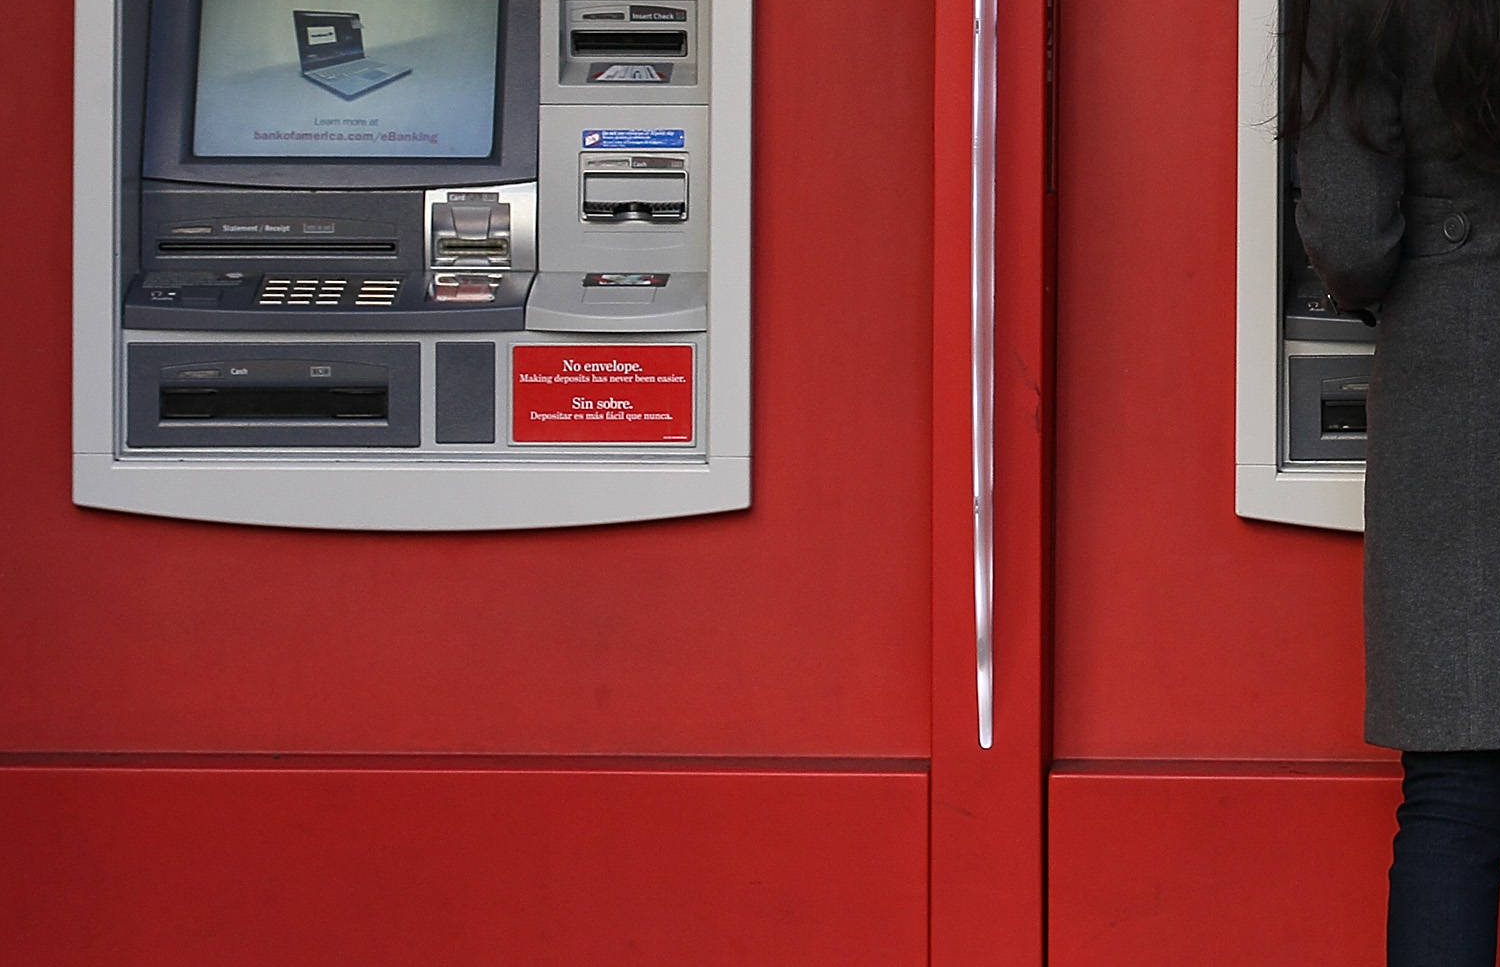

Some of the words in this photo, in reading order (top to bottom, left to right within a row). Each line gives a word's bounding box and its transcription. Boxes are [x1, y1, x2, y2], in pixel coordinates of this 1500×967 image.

[314, 117, 340, 126] Learn
[563, 360, 581, 371] No
[584, 360, 642, 374] envelope.
[520, 374, 552, 383] Making
[554, 374, 590, 384] deposits
[592, 374, 607, 382] has
[635, 374, 655, 382] been
[657, 374, 686, 382] easier.
[572, 397, 593, 409] Sin
[597, 397, 633, 409] sobre.
[531, 411, 572, 421] Depositar
[606, 411, 624, 419] fácil
